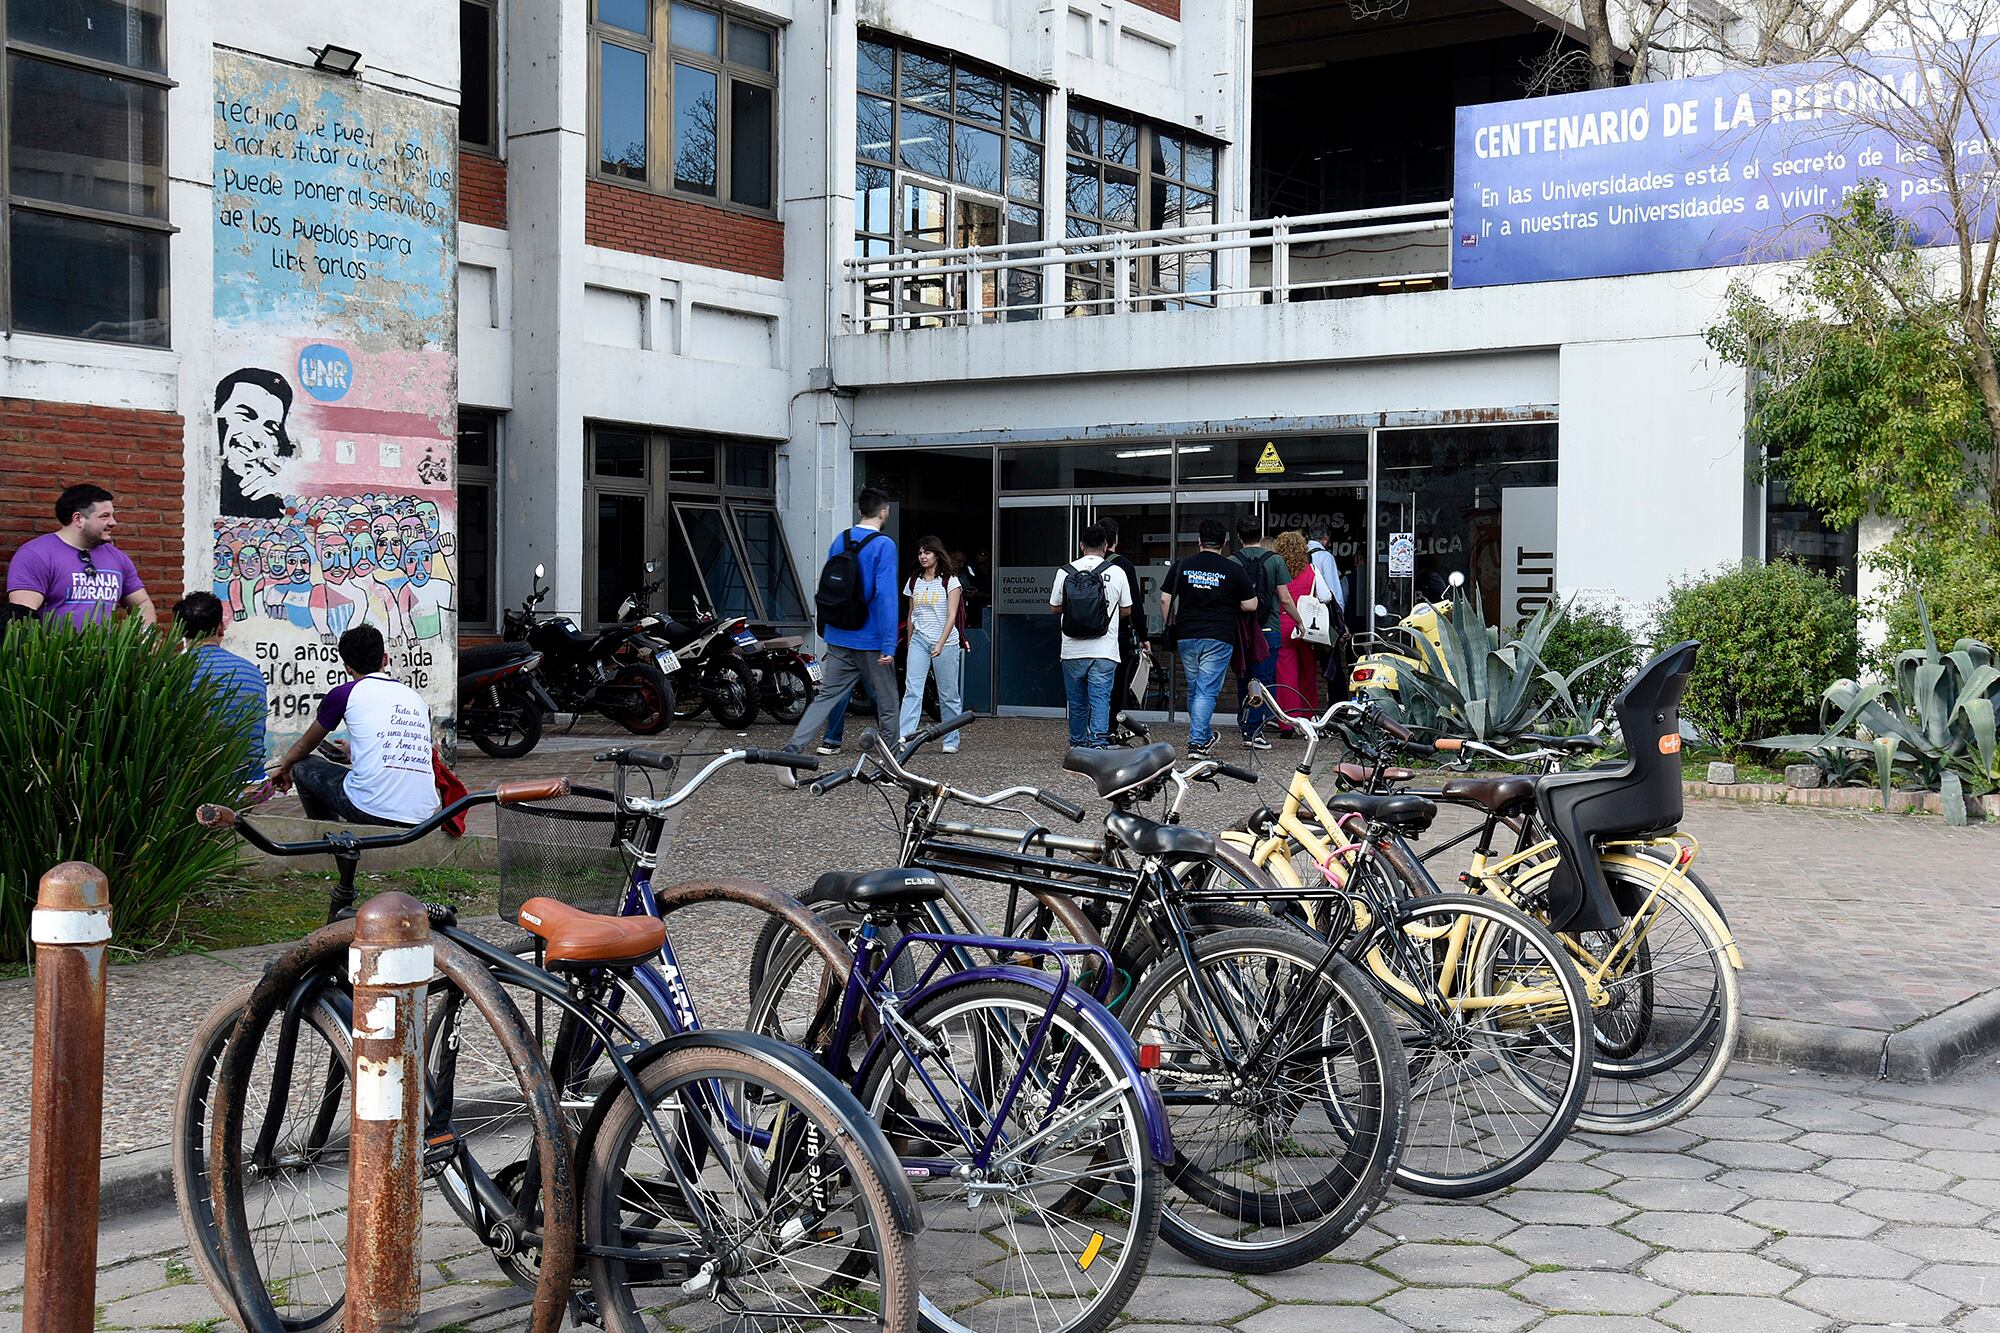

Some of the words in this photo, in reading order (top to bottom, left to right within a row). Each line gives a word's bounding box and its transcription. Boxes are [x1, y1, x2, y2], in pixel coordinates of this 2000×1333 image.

[1475, 105, 1650, 159] CENTENARIO
[1663, 100, 1699, 138] DE
[1714, 93, 1756, 131] LA
[1508, 186, 1532, 205] las
[1542, 171, 1674, 201] Universidades
[1685, 161, 1731, 186] está
[1743, 158, 1760, 180] el
[1772, 151, 1846, 177] secreto
[1858, 147, 1883, 167] de
[1895, 143, 1929, 164] las
[223, 168, 283, 196] puede
[294, 180, 345, 203] poner
[348, 187, 363, 206] al
[369, 190, 436, 220] servicio
[1481, 218, 1493, 238] Ir
[1500, 220, 1511, 236] a
[1521, 210, 1599, 234] nuestras
[1608, 194, 1745, 226] Universidades
[1755, 194, 1770, 211] a
[252, 210, 281, 236] los
[293, 218, 358, 249] pueblos
[368, 231, 412, 256] para
[302, 357, 348, 389] UNR
[71, 586, 118, 602] MORADA
[72, 572, 120, 588] FRANJA
[1002, 576, 1036, 584] FACULTAD
[256, 642, 279, 660] 50
[294, 642, 339, 663] años
[326, 669, 348, 686] en
